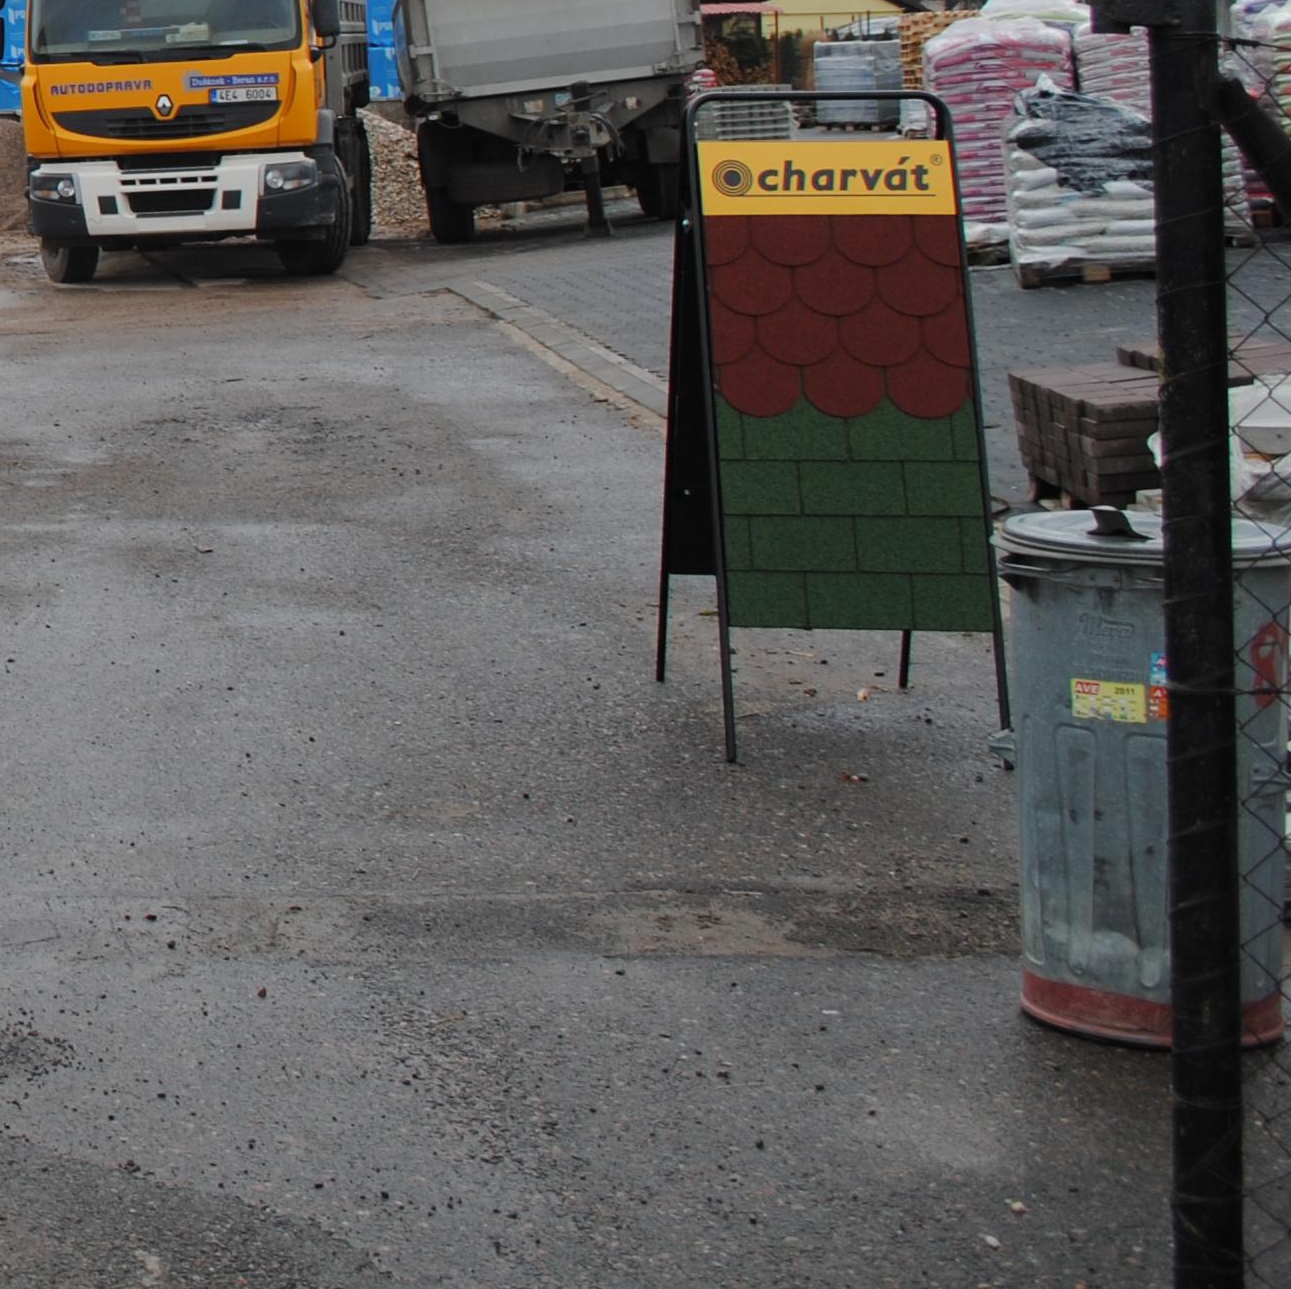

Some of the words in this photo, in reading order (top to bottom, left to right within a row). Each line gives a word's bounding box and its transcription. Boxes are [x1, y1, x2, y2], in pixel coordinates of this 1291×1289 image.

[50, 79, 152, 96] AUTODOPRAVA
[218, 90, 238, 101] 4E4
[245, 88, 272, 100] 6004
[757, 156, 930, 192] charvát
[1074, 682, 1100, 695] AVE
